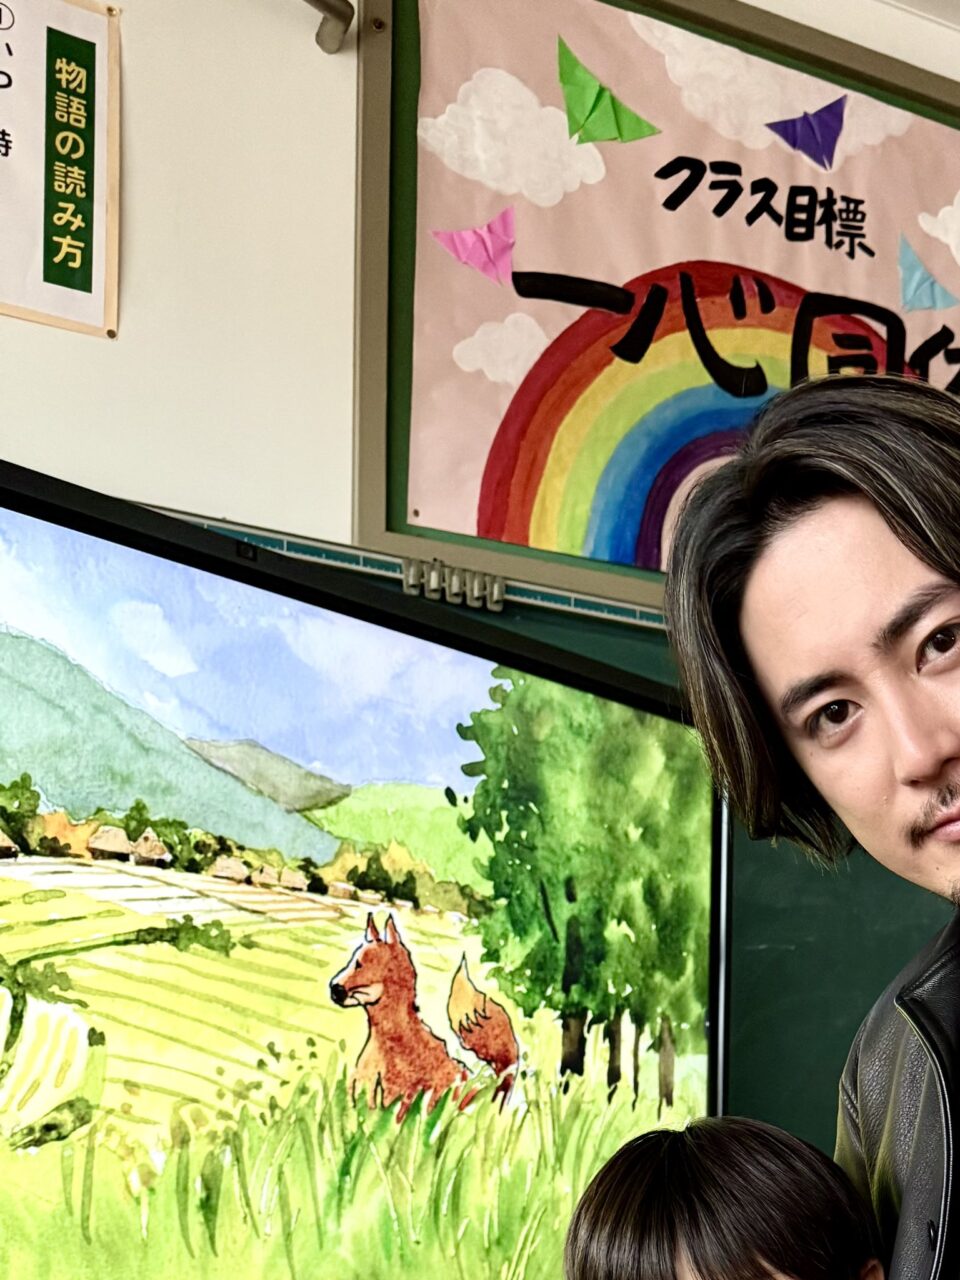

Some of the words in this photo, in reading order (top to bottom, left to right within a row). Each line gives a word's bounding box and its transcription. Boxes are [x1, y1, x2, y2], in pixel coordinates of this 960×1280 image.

[52, 57, 87, 270] 物語の読み方
[654, 155, 875, 260] クラス目標
